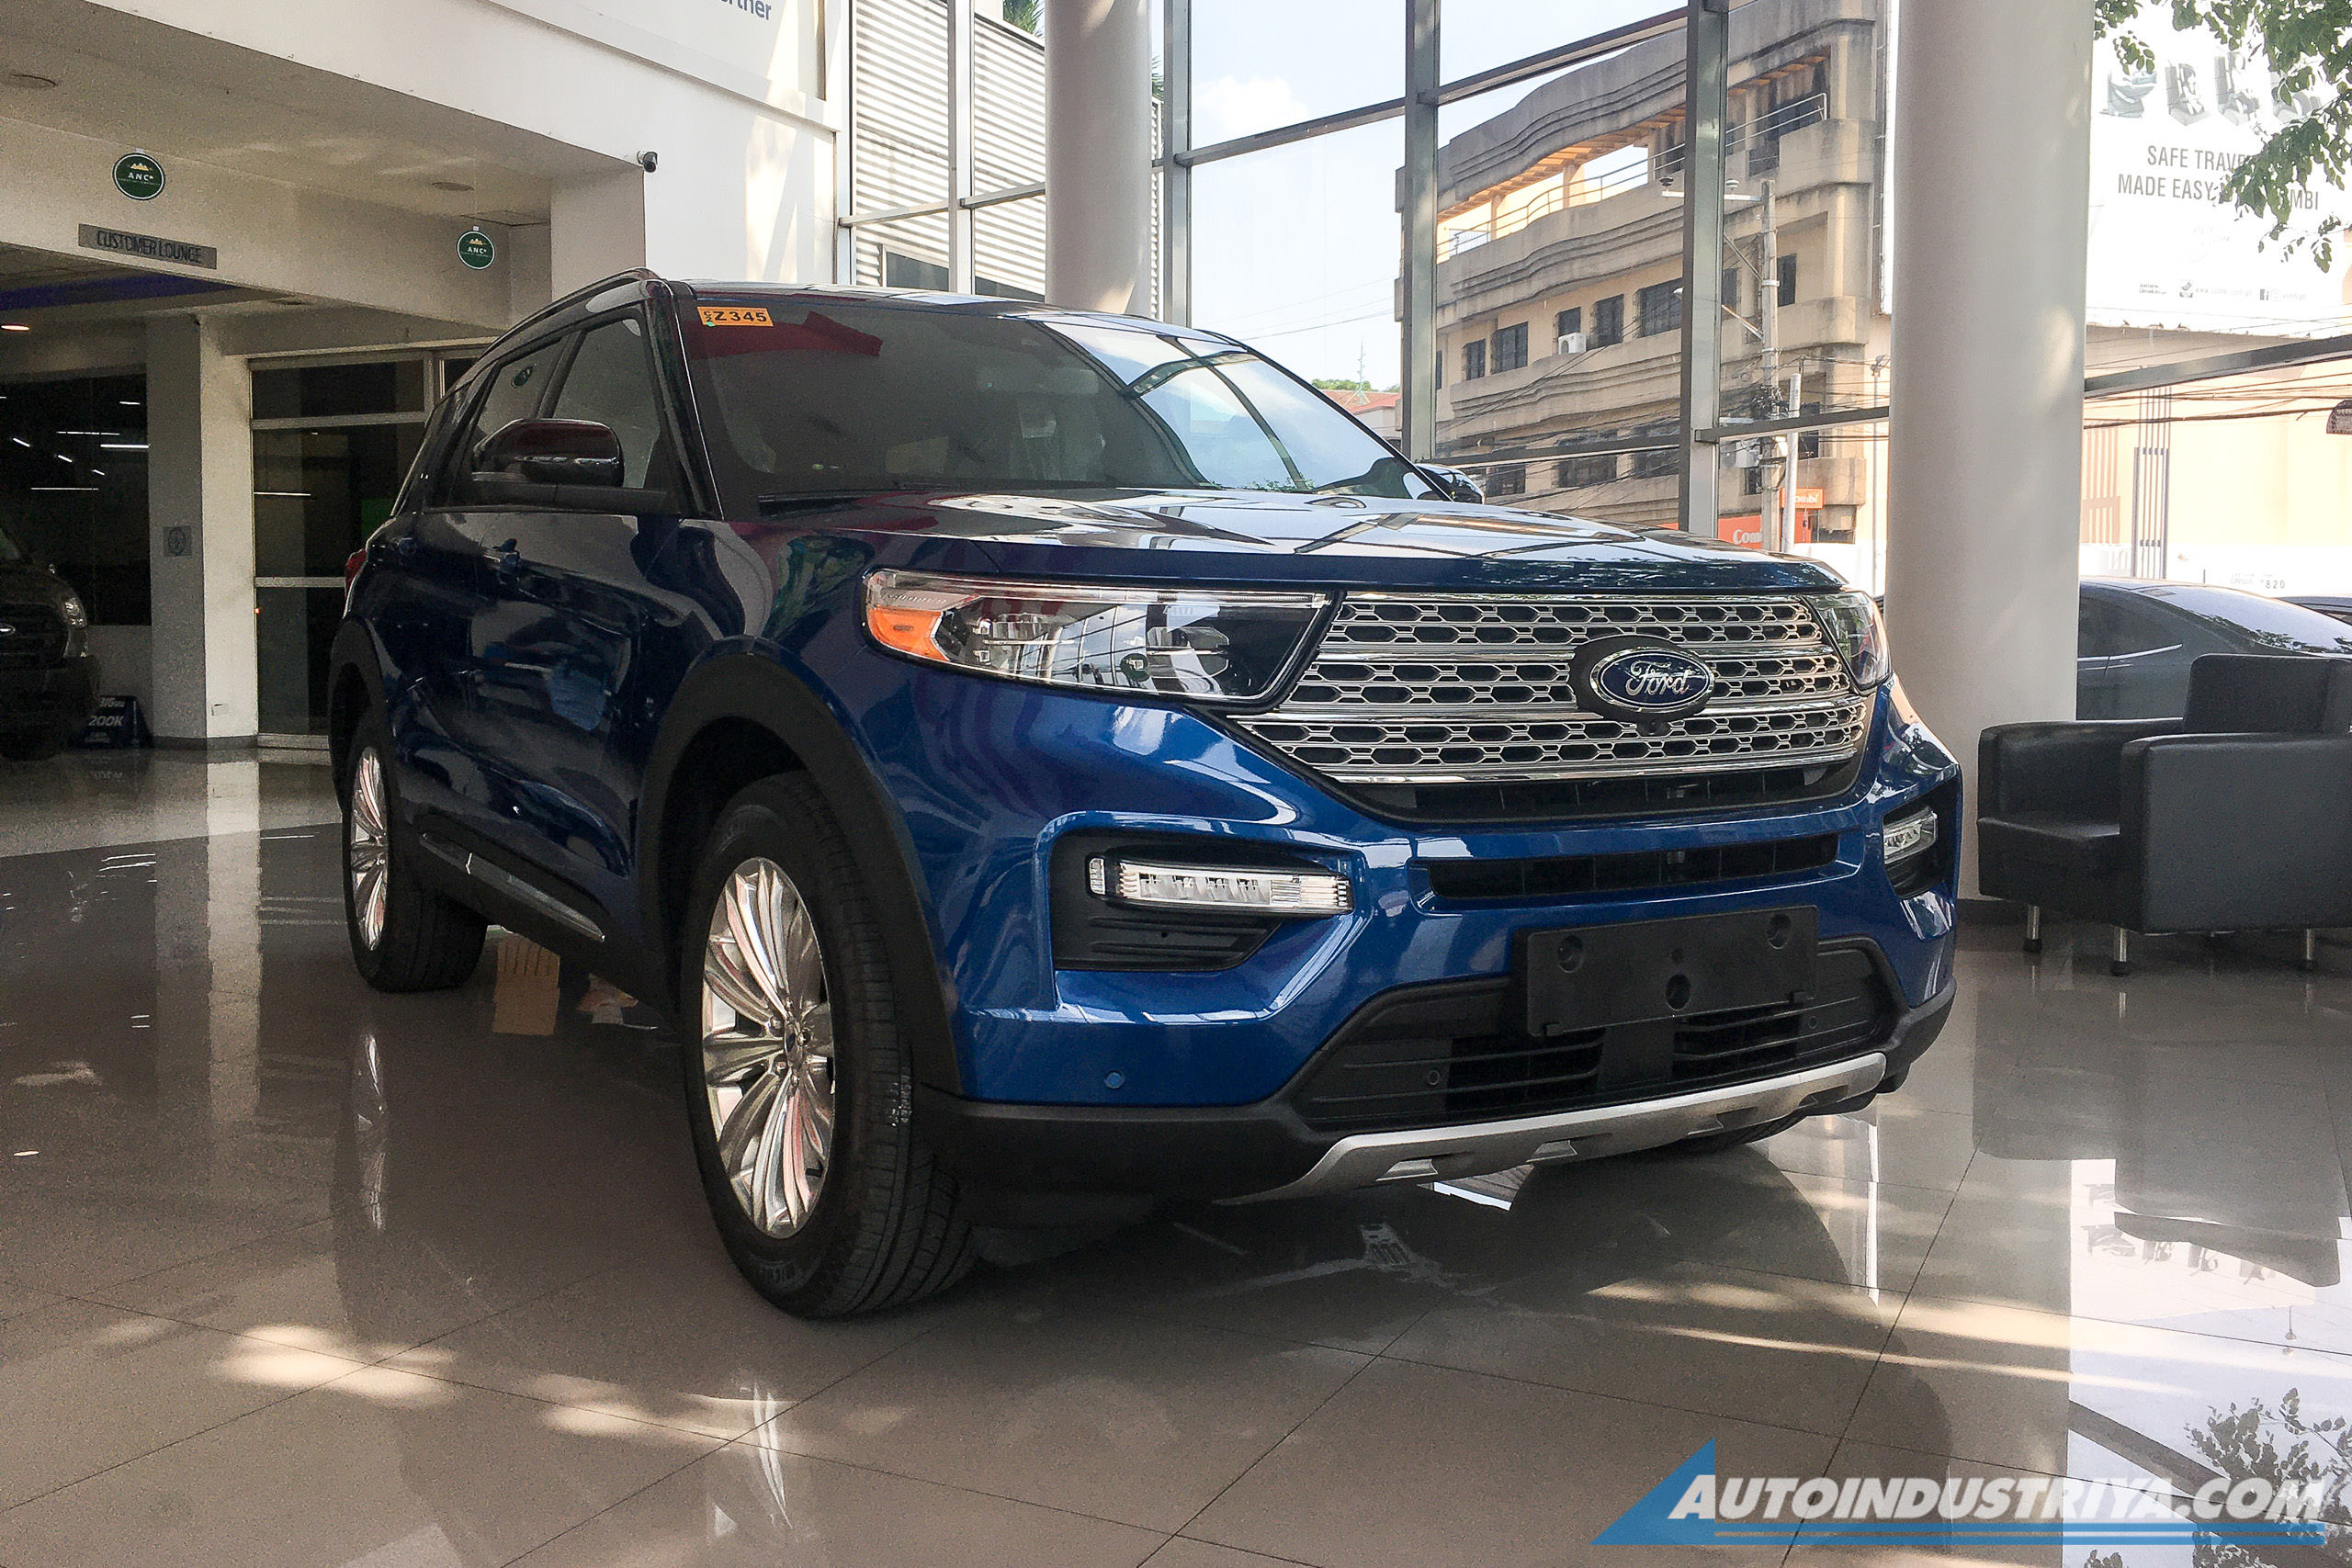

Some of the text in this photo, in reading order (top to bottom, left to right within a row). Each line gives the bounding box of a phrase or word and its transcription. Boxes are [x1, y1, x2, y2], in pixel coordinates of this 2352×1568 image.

[2147, 145, 2247, 172] SAFE TRAVE
[2118, 174, 2166, 197] MADE
[2172, 179, 2214, 201] EASY
[2290, 189, 2319, 210] MBI
[96, 230, 201, 263] CUSTOMER LOUNGE
[1795, 492, 1818, 503] ombi
[1733, 529, 1762, 545] Com
[1625, 660, 1690, 696] Ford
